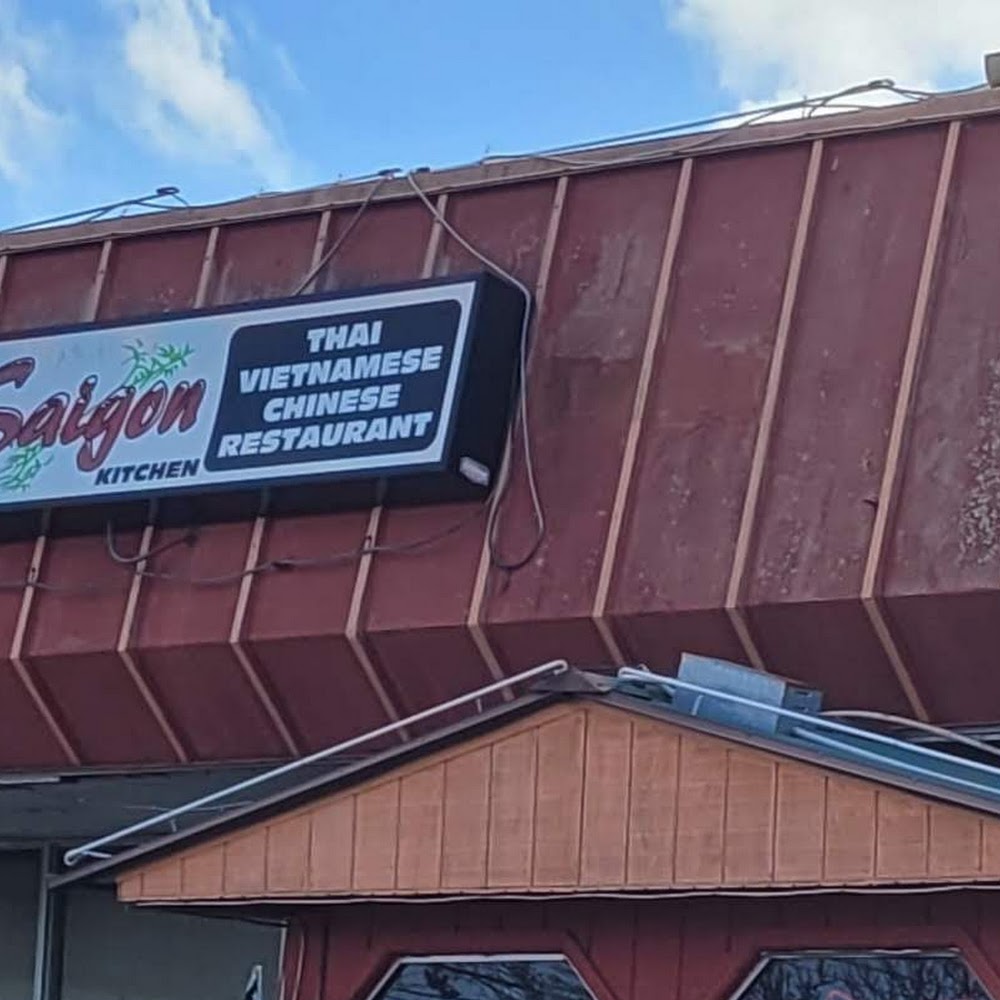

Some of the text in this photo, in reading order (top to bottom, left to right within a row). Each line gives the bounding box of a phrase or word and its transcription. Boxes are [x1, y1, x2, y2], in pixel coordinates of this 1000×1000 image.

[306, 320, 383, 353] THAI
[239, 345, 444, 394] VIETNAMESE
[262, 383, 403, 423] CHINESE
[216, 411, 434, 459] RESTAURANT
[94, 458, 201, 486] KITCHEN
